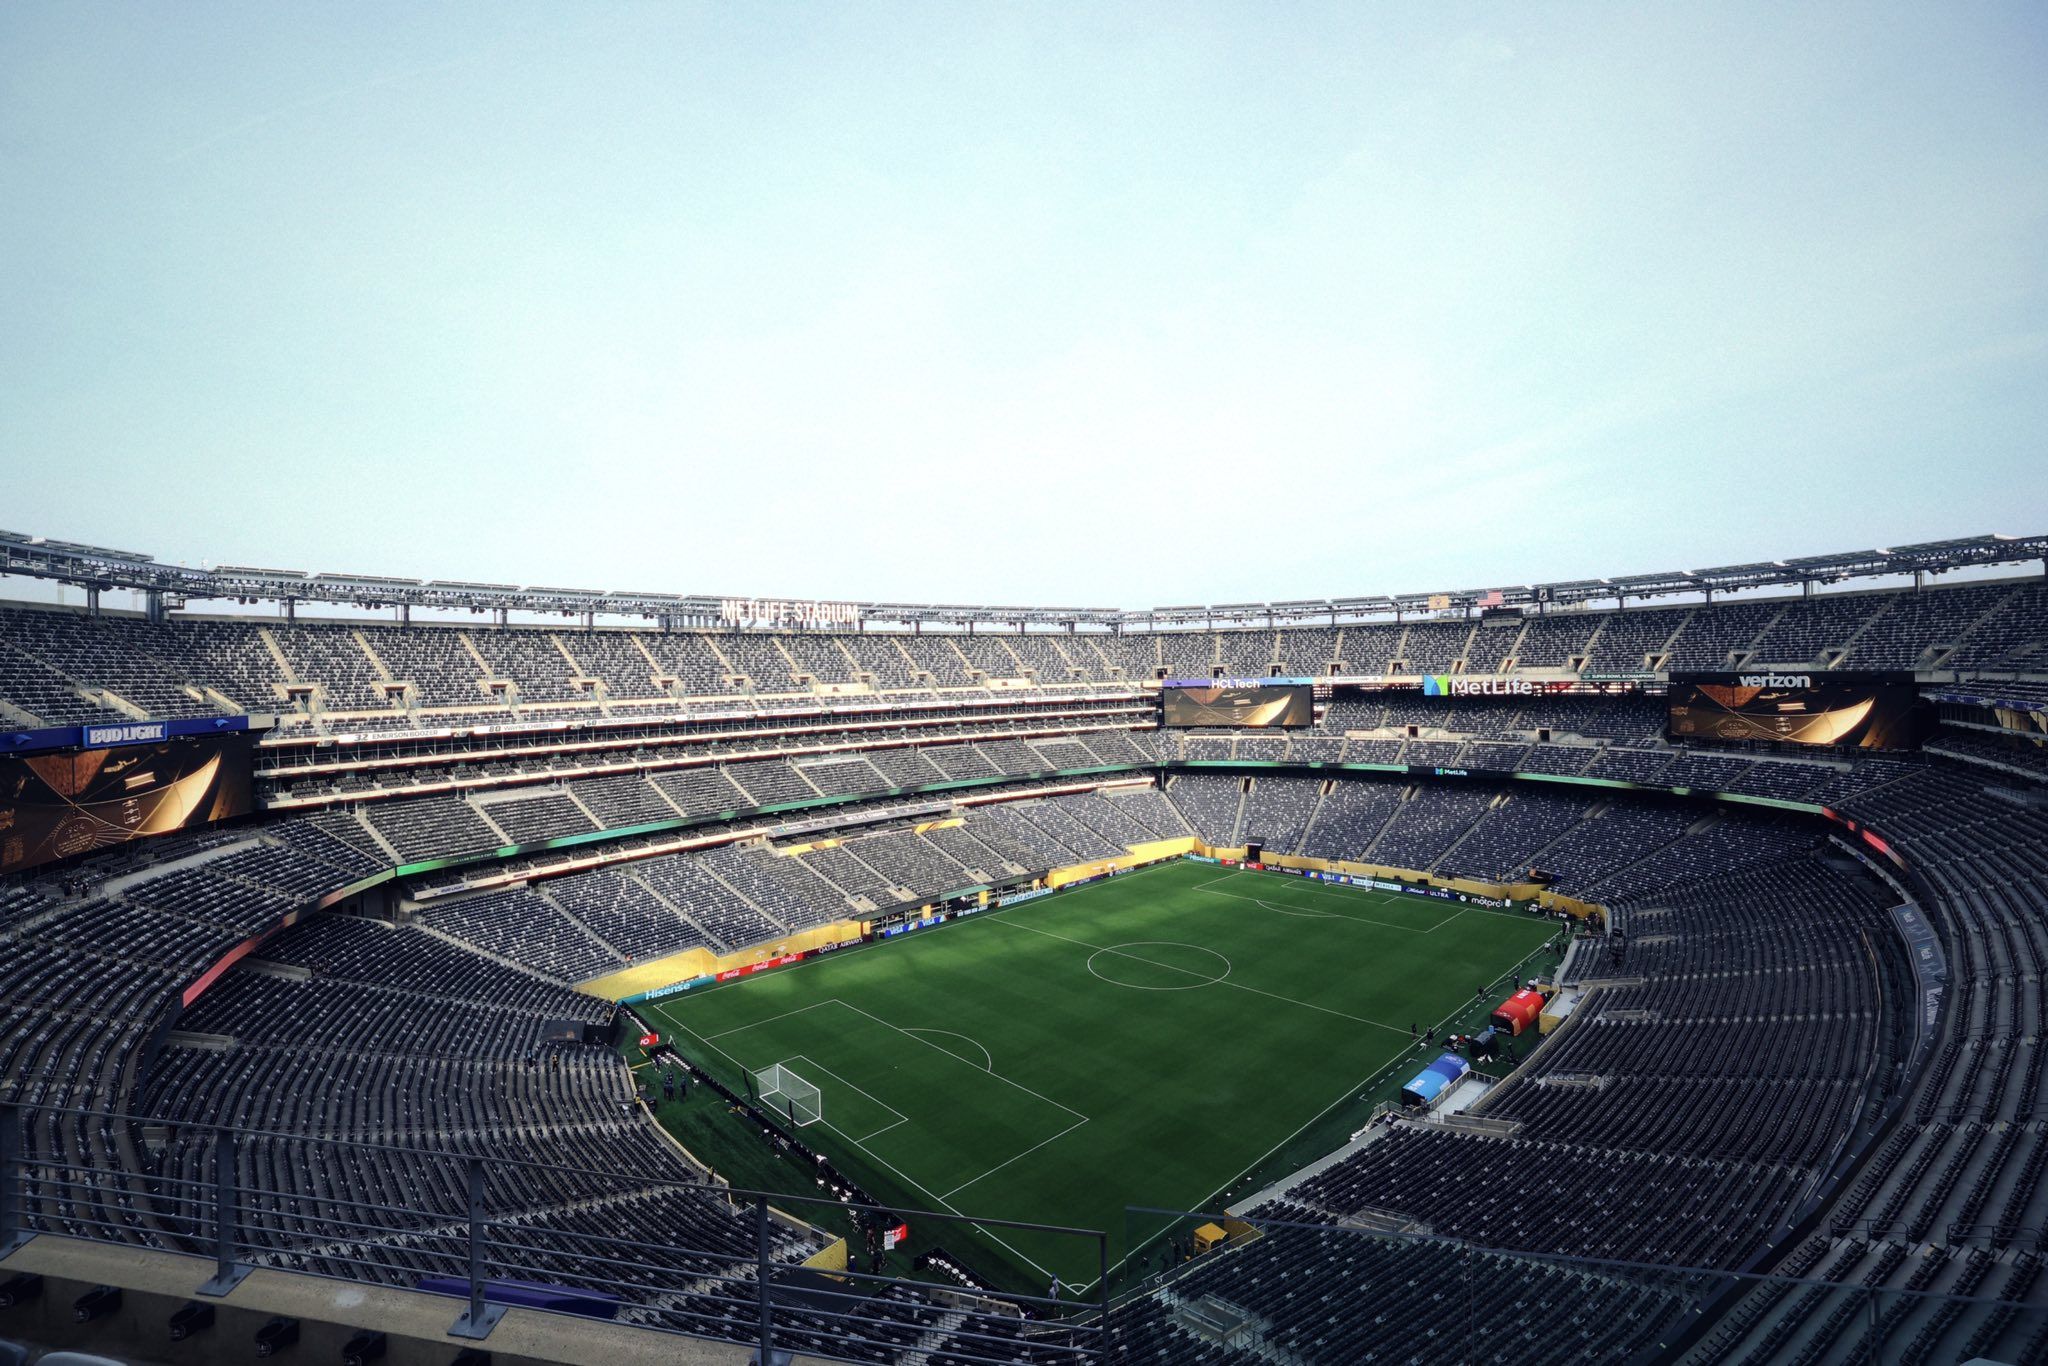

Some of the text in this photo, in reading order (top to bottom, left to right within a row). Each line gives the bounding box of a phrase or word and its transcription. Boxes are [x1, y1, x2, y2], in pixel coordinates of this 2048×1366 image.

[721, 600, 859, 623] METLIFE STADIUM
[1211, 679, 1261, 688] HCLTech
[1451, 678, 1533, 695] MetLife
[1739, 672, 1811, 688] verizon
[89, 725, 163, 744] BUD LIGHT
[372, 731, 408, 740] EMERSON
[409, 729, 438, 737] BOOZER
[1265, 864, 1281, 872] QATAR
[1429, 890, 1450, 899] ULTRA
[922, 916, 935, 928] VISA
[889, 923, 904, 936] VISA
[818, 937, 864, 954] QATAR AIRWAYS
[645, 981, 691, 1000] Hisense
